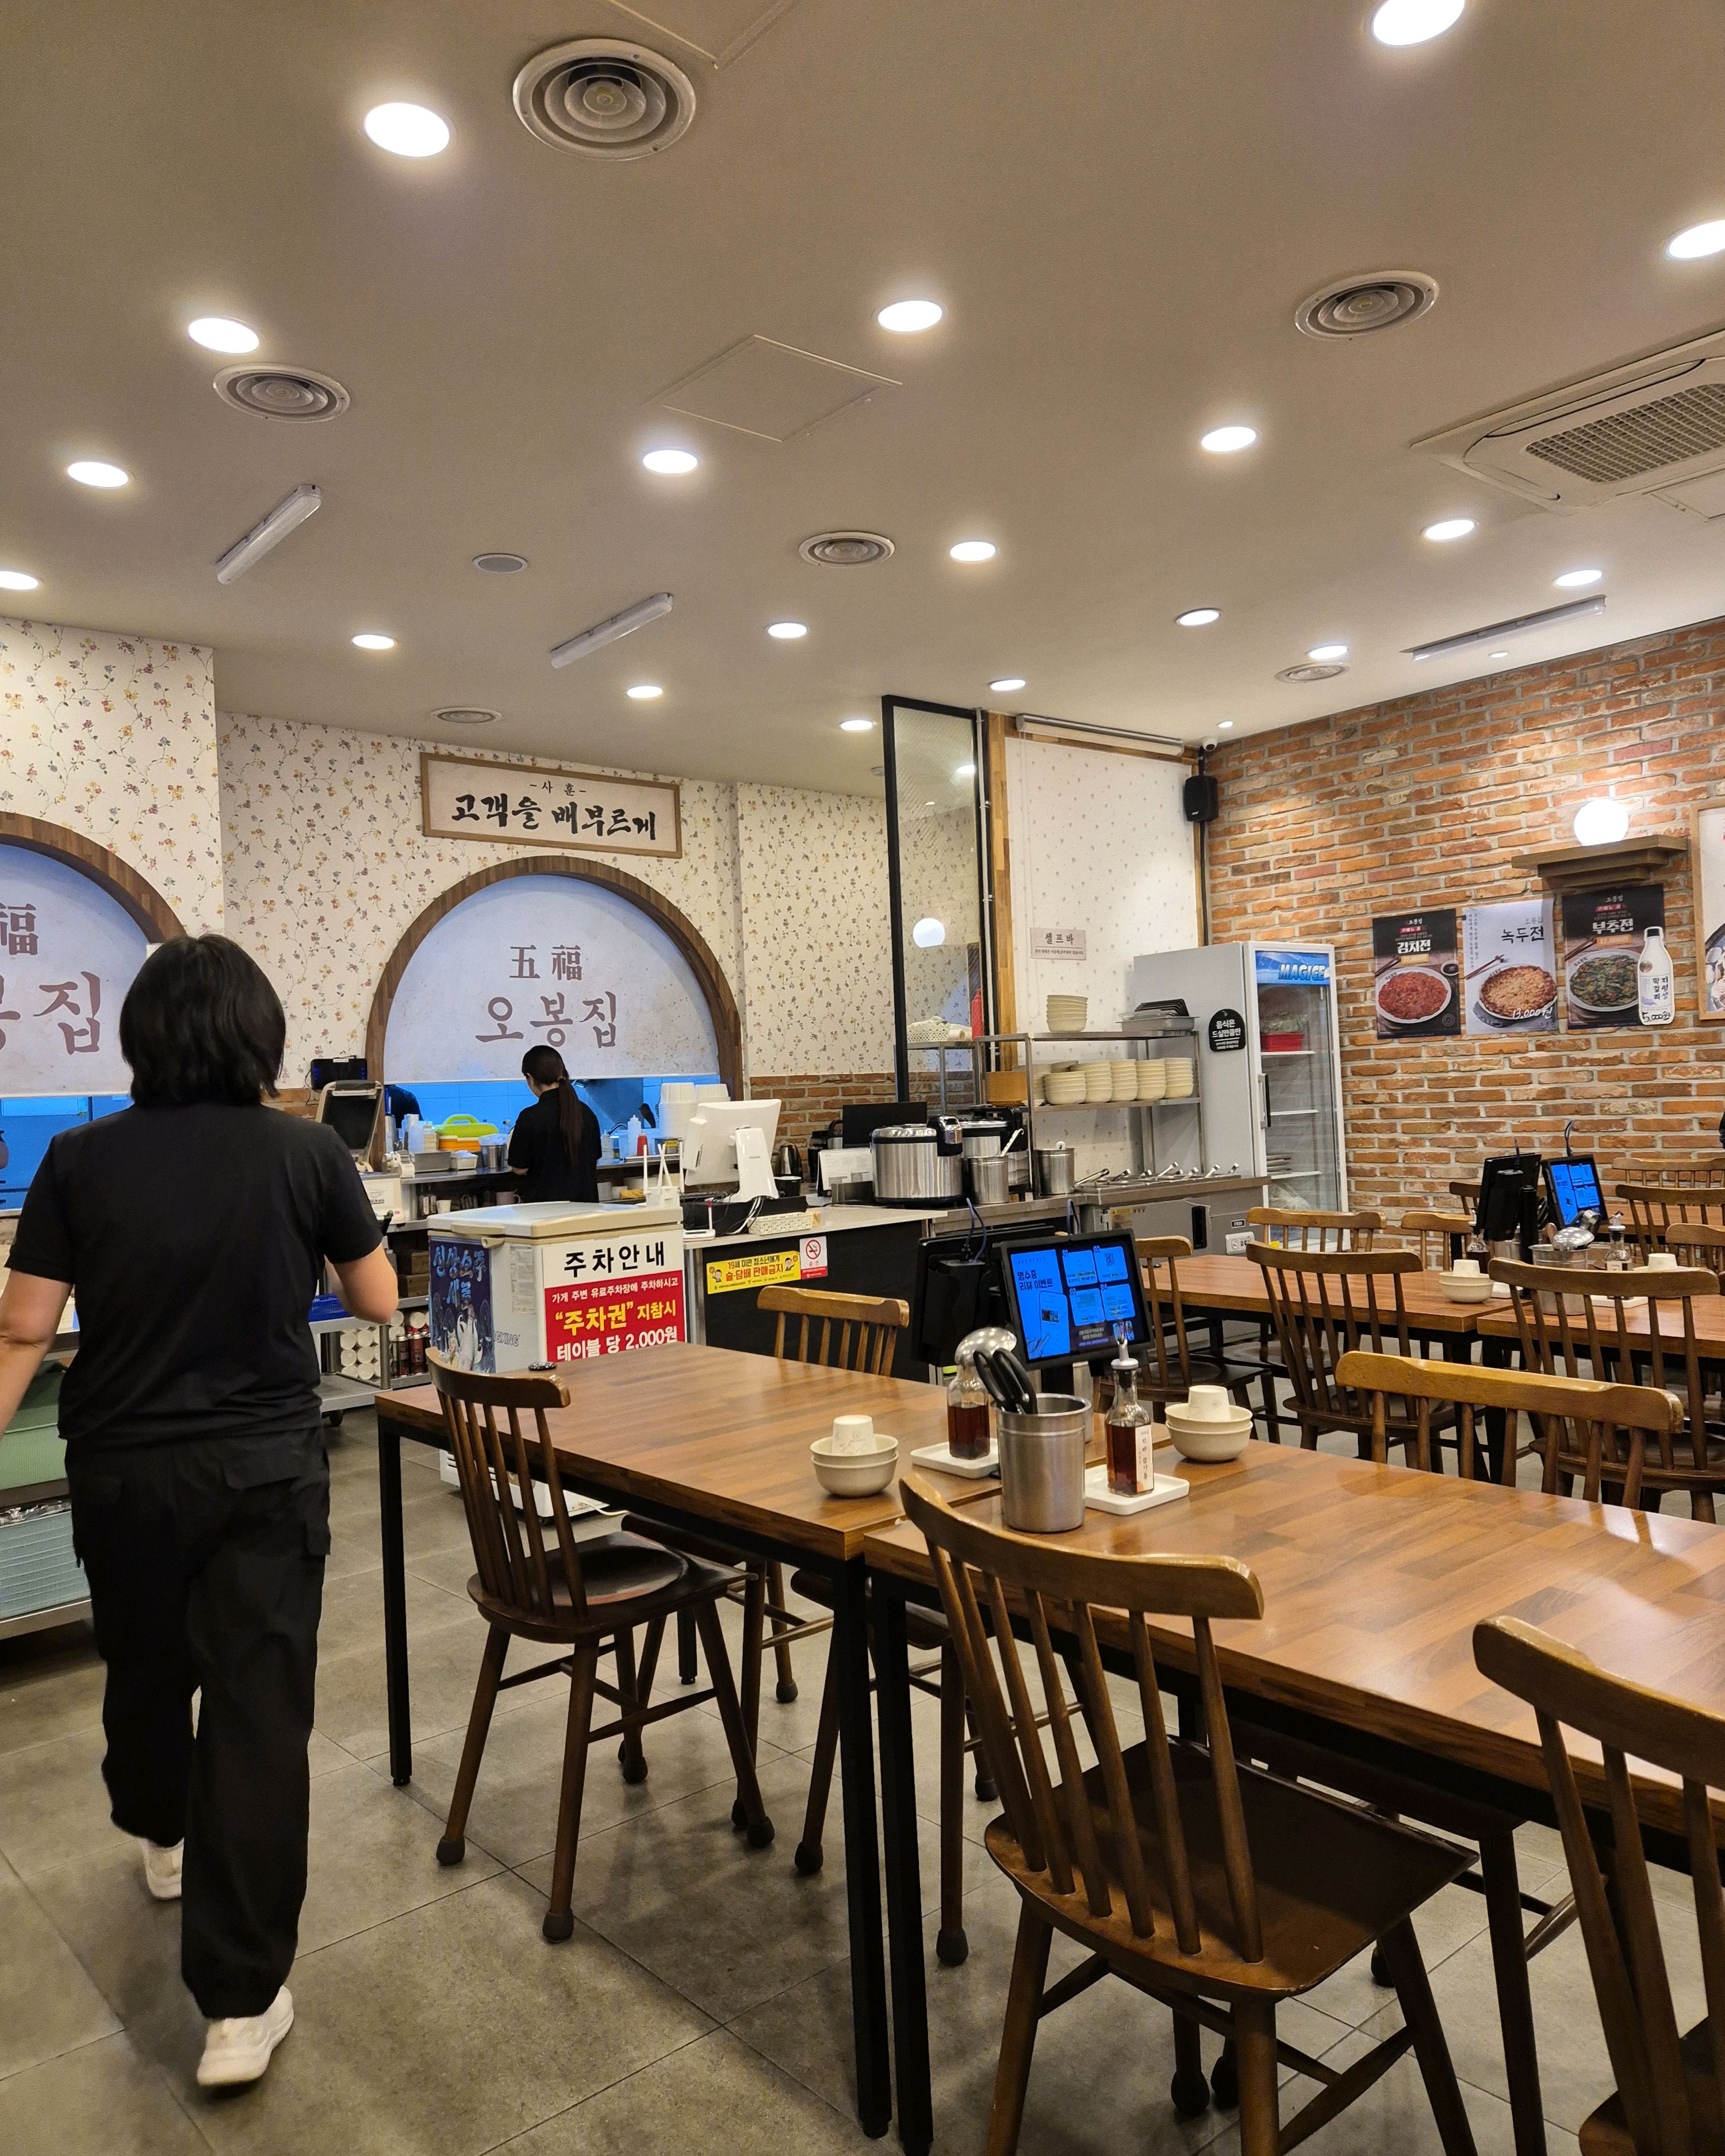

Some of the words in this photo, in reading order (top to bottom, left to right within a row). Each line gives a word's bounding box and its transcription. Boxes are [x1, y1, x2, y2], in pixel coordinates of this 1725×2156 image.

[451, 793, 542, 830] 고객을
[551, 801, 656, 840] 배부르게
[1501, 925, 1545, 943] 녹두전
[1592, 918, 1634, 934] 부추전
[1045, 932, 1074, 946] 셀프바
[1397, 939, 1431, 954] 김치전
[1653, 977, 1661, 1000] 막걸리
[0, 970, 101, 1055] 집
[475, 991, 616, 1048] 오봉집
[1212, 1027, 1241, 1038] 드실만큼만
[1216, 1019, 1236, 1029] 음식은
[564, 1241, 664, 1278] 주차안내
[728, 1261, 740, 1270] 19세
[742, 1259, 752, 1267] 미만
[754, 1255, 780, 1265] 청소년에게
[753, 1264, 783, 1276] 판매금지
[1018, 1269, 1037, 1281] 영수증
[552, 1292, 568, 1303] 가게
[572, 1289, 587, 1301] 주변
[591, 1282, 638, 1298] 유료주차장에
[641, 1278, 678, 1291] 주차하시고
[1019, 1281, 1033, 1291] 리뷰
[1034, 1278, 1053, 1288] 이벤트
[637, 1299, 676, 1321] 지참시
[557, 1338, 601, 1361] 테이블
[606, 1335, 620, 1354] 당
[626, 1326, 677, 1351] 2,000원
